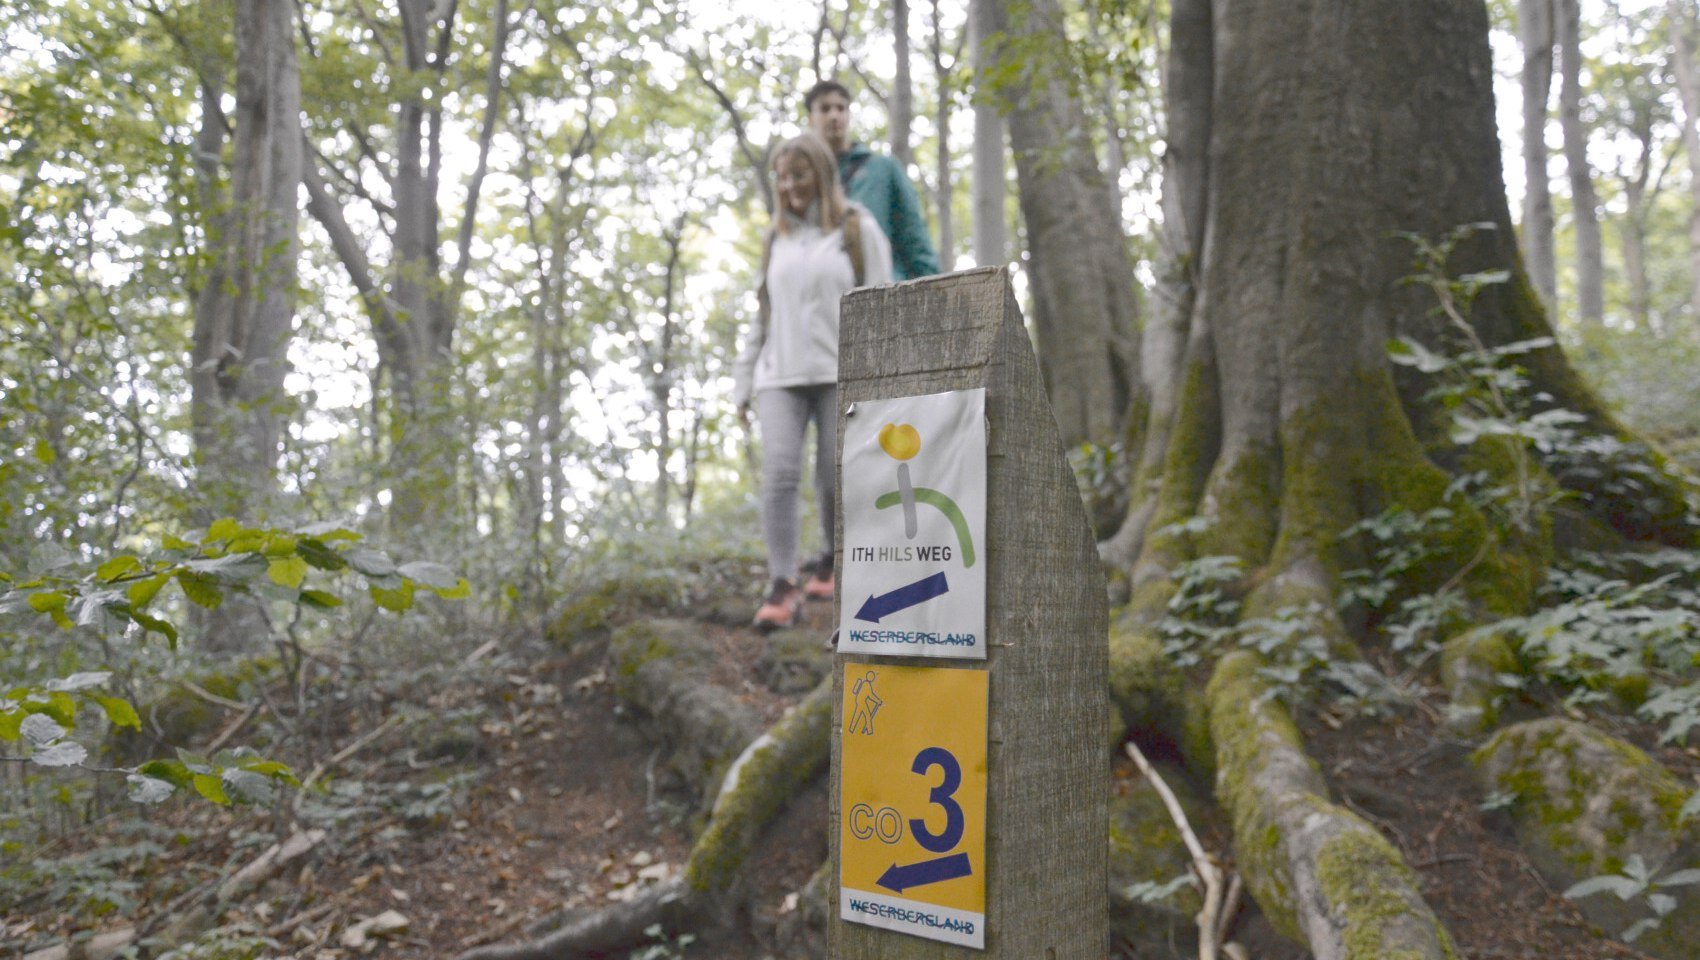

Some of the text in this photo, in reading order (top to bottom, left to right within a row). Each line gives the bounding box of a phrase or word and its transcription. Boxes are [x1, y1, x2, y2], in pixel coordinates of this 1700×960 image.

[852, 546, 952, 562] ITH HILS WEG
[849, 630, 976, 647] WESERBERGLAND
[849, 746, 965, 853] CO 3
[849, 898, 975, 935] WESERBERGLAND
